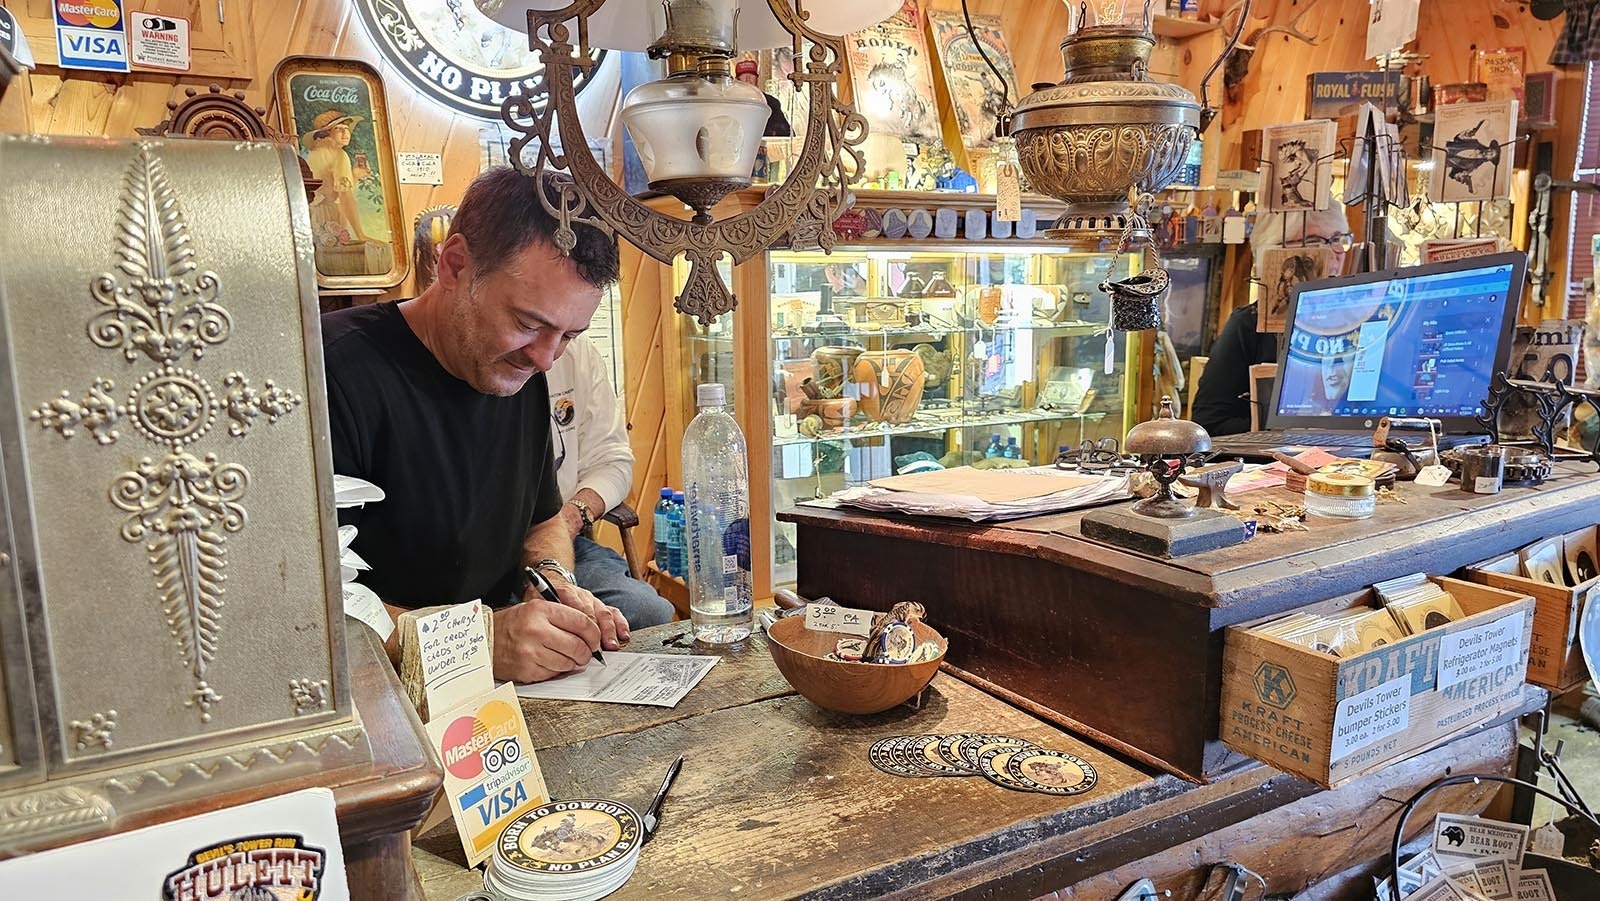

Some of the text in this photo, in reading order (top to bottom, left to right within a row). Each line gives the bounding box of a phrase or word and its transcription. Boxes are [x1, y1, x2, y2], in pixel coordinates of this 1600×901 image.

[59, 3, 118, 18] MasterCard
[66, 33, 121, 55] VISA
[142, 30, 178, 42] WARNING
[418, 51, 462, 90] NO
[1316, 83, 1395, 98] ROYAL FLUSH
[1459, 626, 1506, 649] Devils Tower
[1443, 648, 1488, 670] Refrigerator
[1489, 636, 1518, 653] Magnets
[1343, 641, 1439, 699] KRAFT
[1456, 665, 1469, 677] 3.00
[1242, 701, 1304, 731] KRAFT
[1347, 687, 1402, 717] Devils Tower
[1474, 696, 1499, 713] PROCESS
[1232, 710, 1313, 750] PROCESS CHEESE
[1338, 700, 1407, 737] bumper Stickers
[1345, 735, 1359, 748] 3.00
[1377, 723, 1386, 732] for
[1386, 716, 1400, 729] 5.00
[1232, 727, 1310, 763] AMERICAN
[1352, 746, 1380, 764] POUNDS
[1383, 739, 1397, 752] NET
[486, 760, 528, 791] tripadvisor
[1015, 750, 1040, 761] BORN
[1062, 753, 1094, 778] COWBOY
[1021, 777, 1034, 786] NO
[1036, 784, 1065, 792] PLAN
[477, 780, 527, 826] VISA
[503, 801, 626, 850] BORN TO COWBOY
[1487, 830, 1519, 840] MEDICINE
[195, 838, 297, 864] DEVIL'S TOWER RUN
[548, 841, 630, 871] NO PLAN B
[1470, 836, 1513, 850] BEAR ROOT
[170, 848, 321, 901] HULETT
[1481, 876, 1501, 887] ROOT
